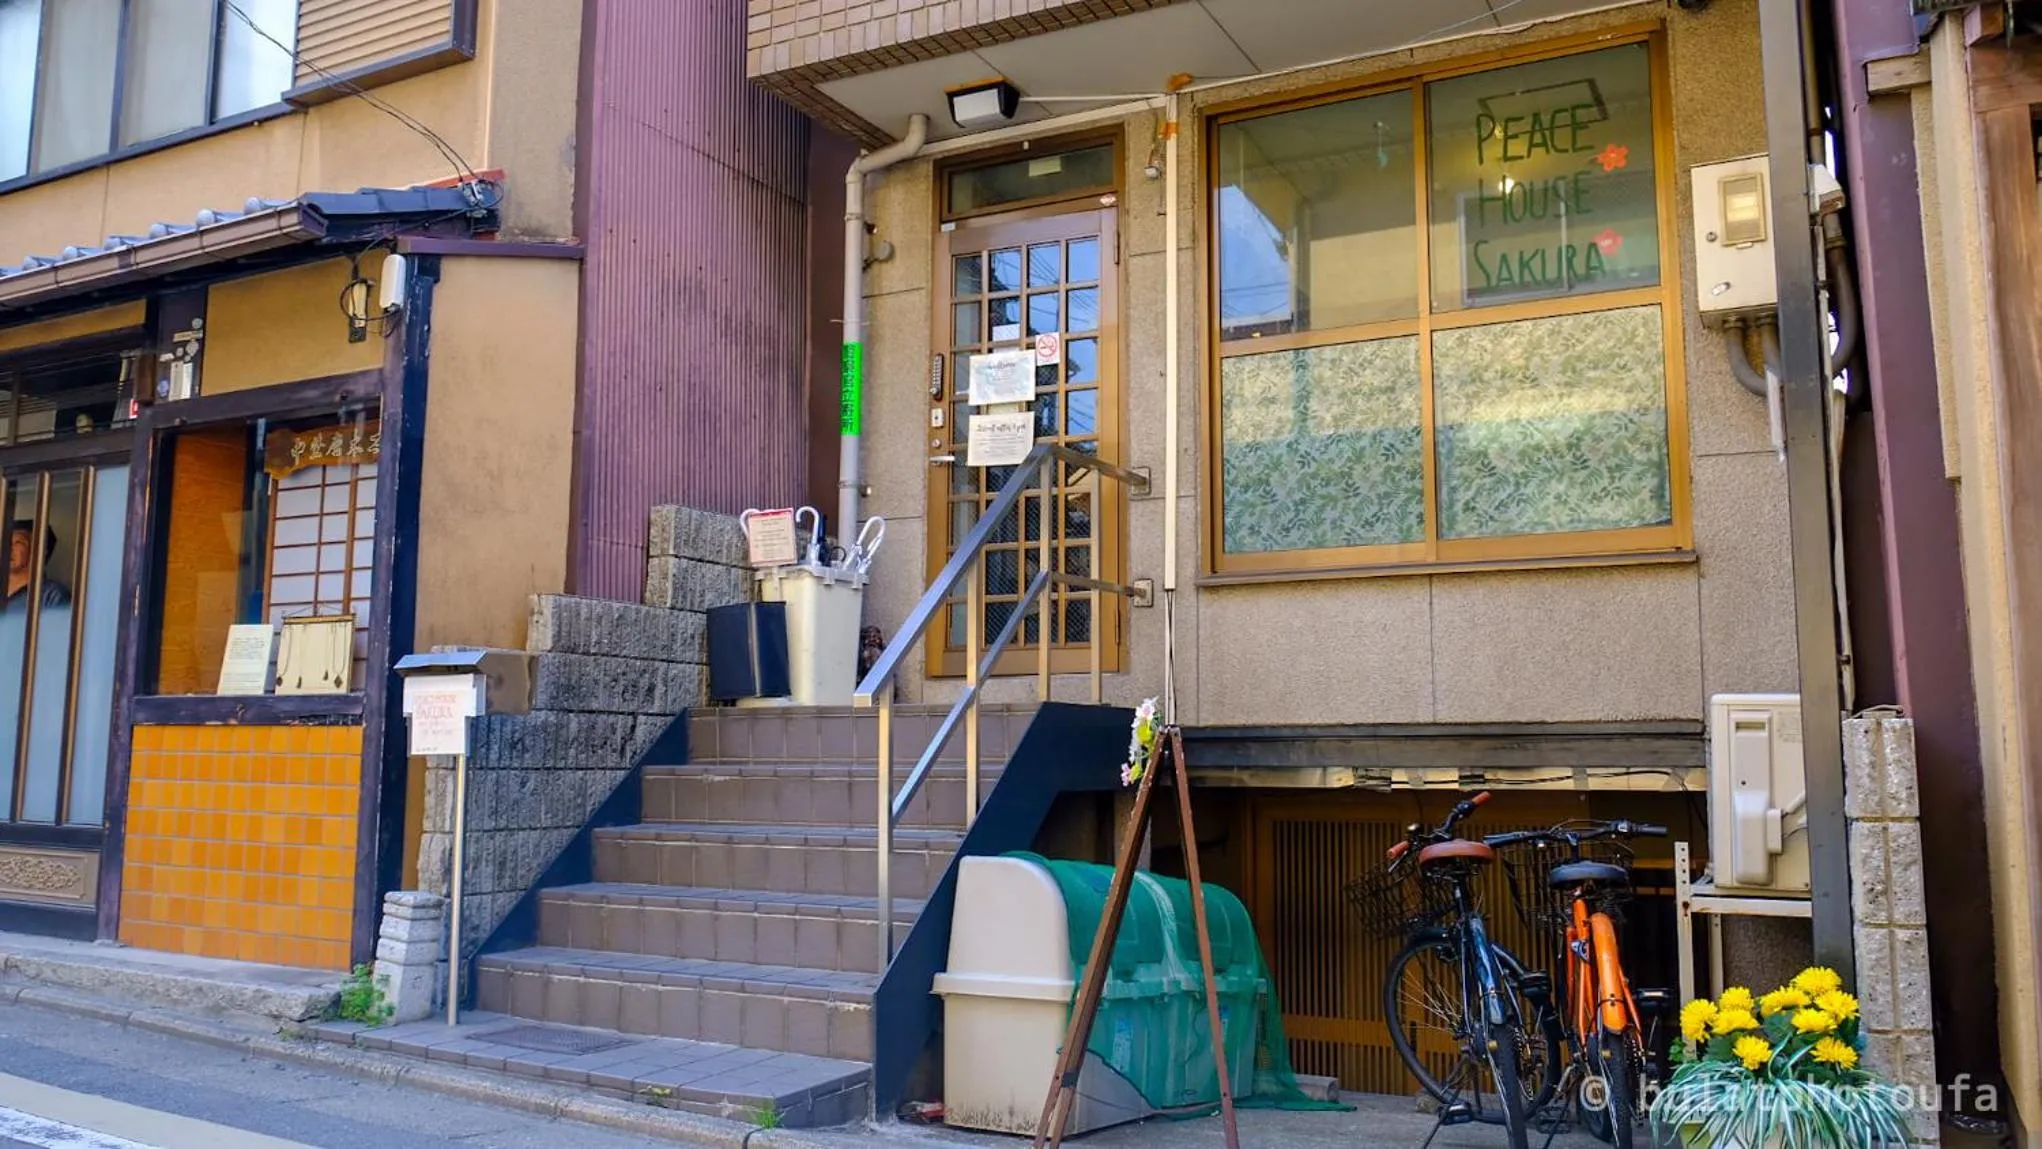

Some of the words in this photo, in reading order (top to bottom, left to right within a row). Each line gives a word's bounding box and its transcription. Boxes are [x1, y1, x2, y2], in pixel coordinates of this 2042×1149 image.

[1475, 103, 1596, 166] PEACE
[1478, 170, 1594, 229] HOUSE
[1473, 240, 1607, 290] SAKURA
